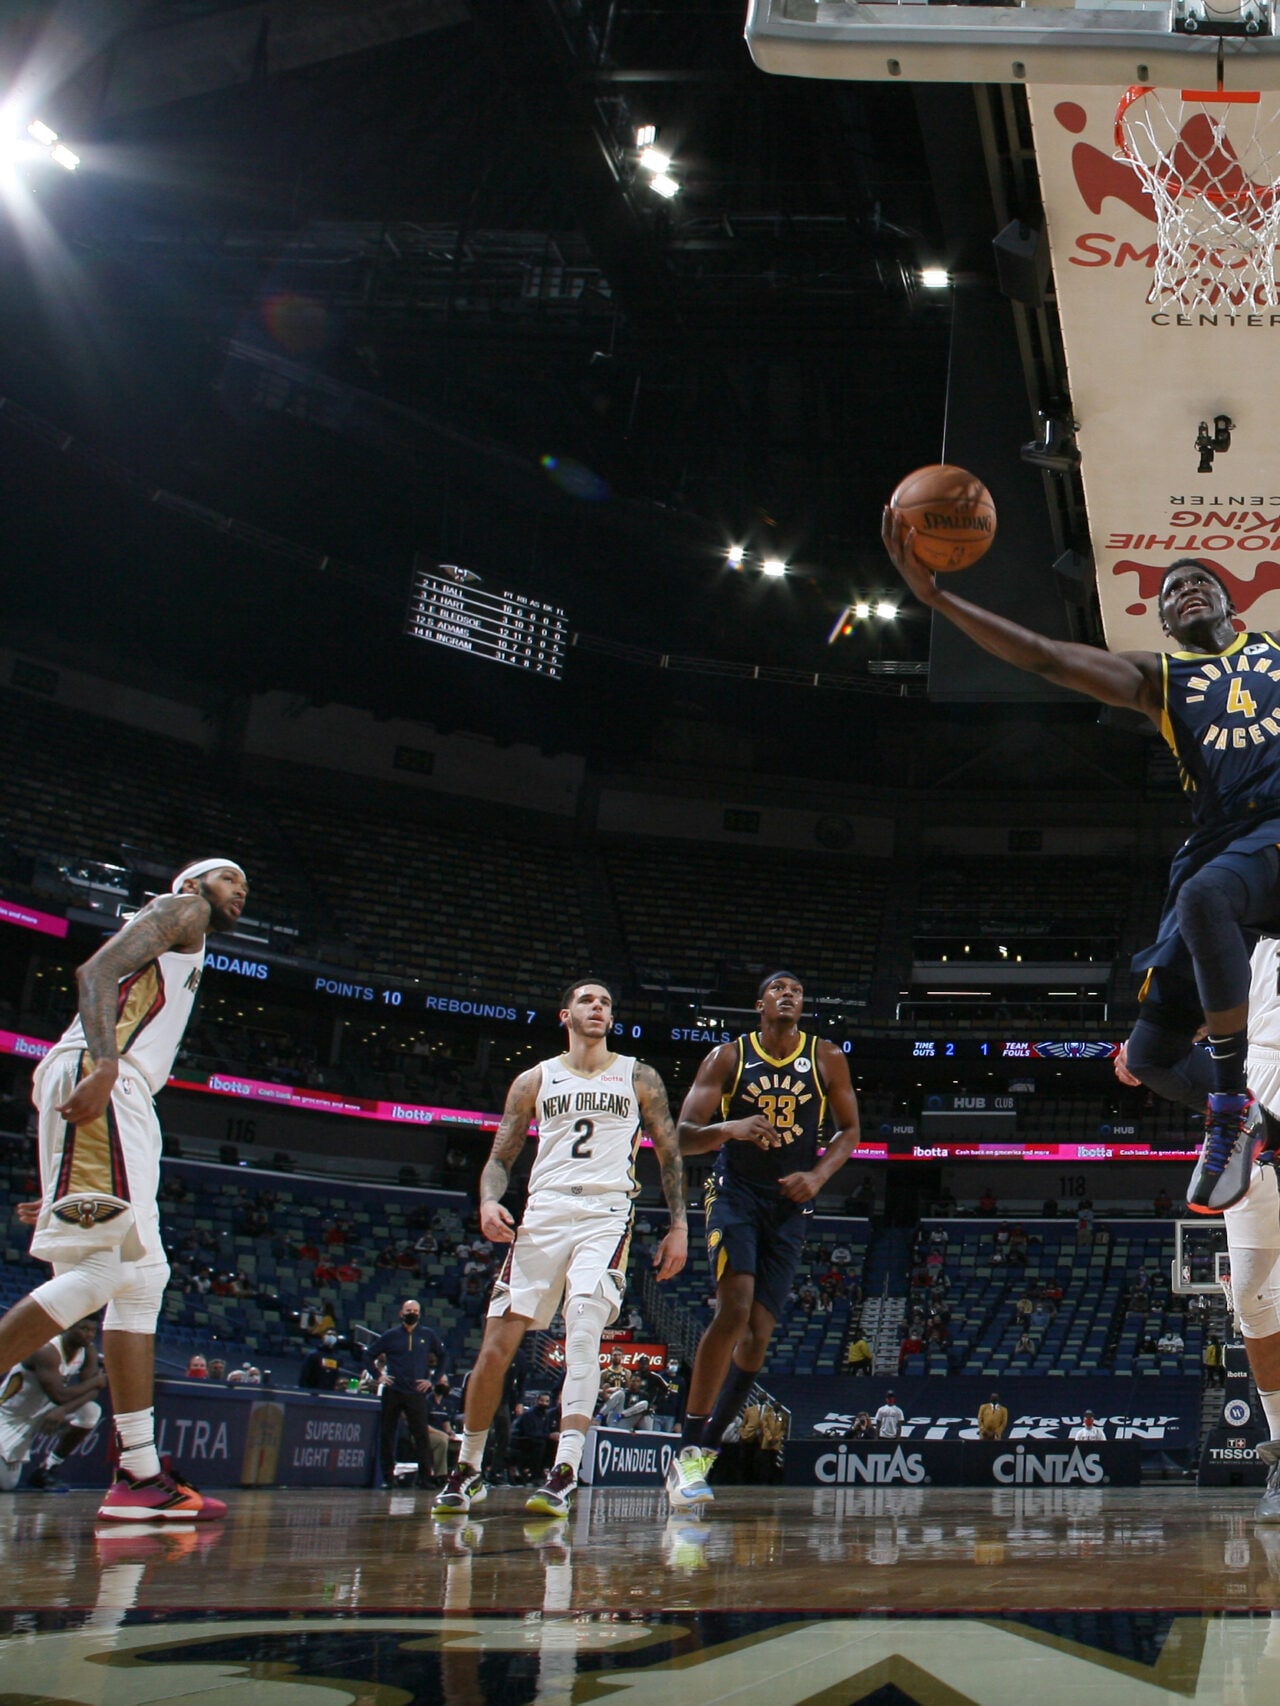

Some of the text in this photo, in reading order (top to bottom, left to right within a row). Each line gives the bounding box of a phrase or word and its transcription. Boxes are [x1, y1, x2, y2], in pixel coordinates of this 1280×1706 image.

[924, 512, 991, 533] SPALDING
[1227, 677, 1258, 718] 4
[204, 953, 268, 979] ADAMS
[315, 977, 401, 1005] POINTS 10
[426, 995, 536, 1024] REBOUNDS 7
[671, 1028, 731, 1044] STEALS
[912, 1042, 935, 1057] TIME OUTS
[946, 1043, 988, 1055] 2 1
[1003, 1042, 1030, 1057] TEAM FOULS
[210, 1077, 250, 1094] ibotta
[741, 1074, 812, 1105] INDIANA
[392, 1107, 433, 1121] ibotta
[543, 1092, 631, 1121] NEW ORLEANS
[758, 1095, 796, 1128] 33
[953, 1098, 1014, 1109] HUB CLUB
[572, 1118, 594, 1159] 2
[893, 1126, 915, 1134] HUB
[1113, 1126, 1135, 1134] HUB
[913, 1147, 948, 1157] ibotta
[1078, 1147, 1113, 1157] ibotta
[157, 1418, 229, 1459] LTRA
[305, 1420, 361, 1442] SUPERIOR
[293, 1447, 366, 1468] LIGHT BEER
[611, 1446, 657, 1473] FANDUEL
